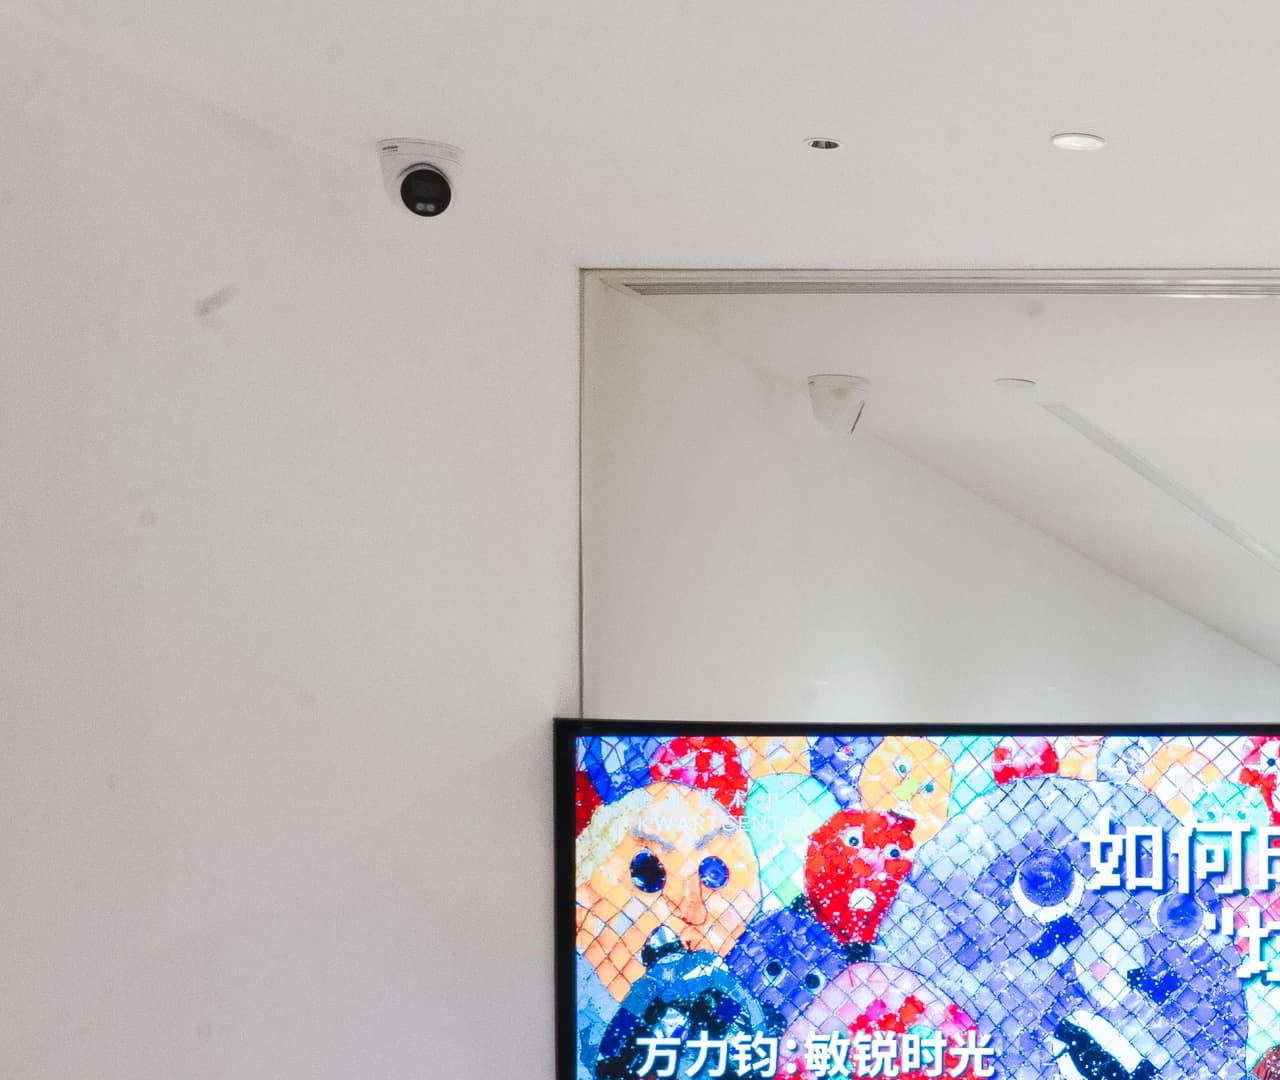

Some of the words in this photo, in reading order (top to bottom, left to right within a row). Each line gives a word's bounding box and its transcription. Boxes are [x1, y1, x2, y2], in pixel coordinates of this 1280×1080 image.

[636, 1030, 996, 1078] 方力钧：敏锐时光
